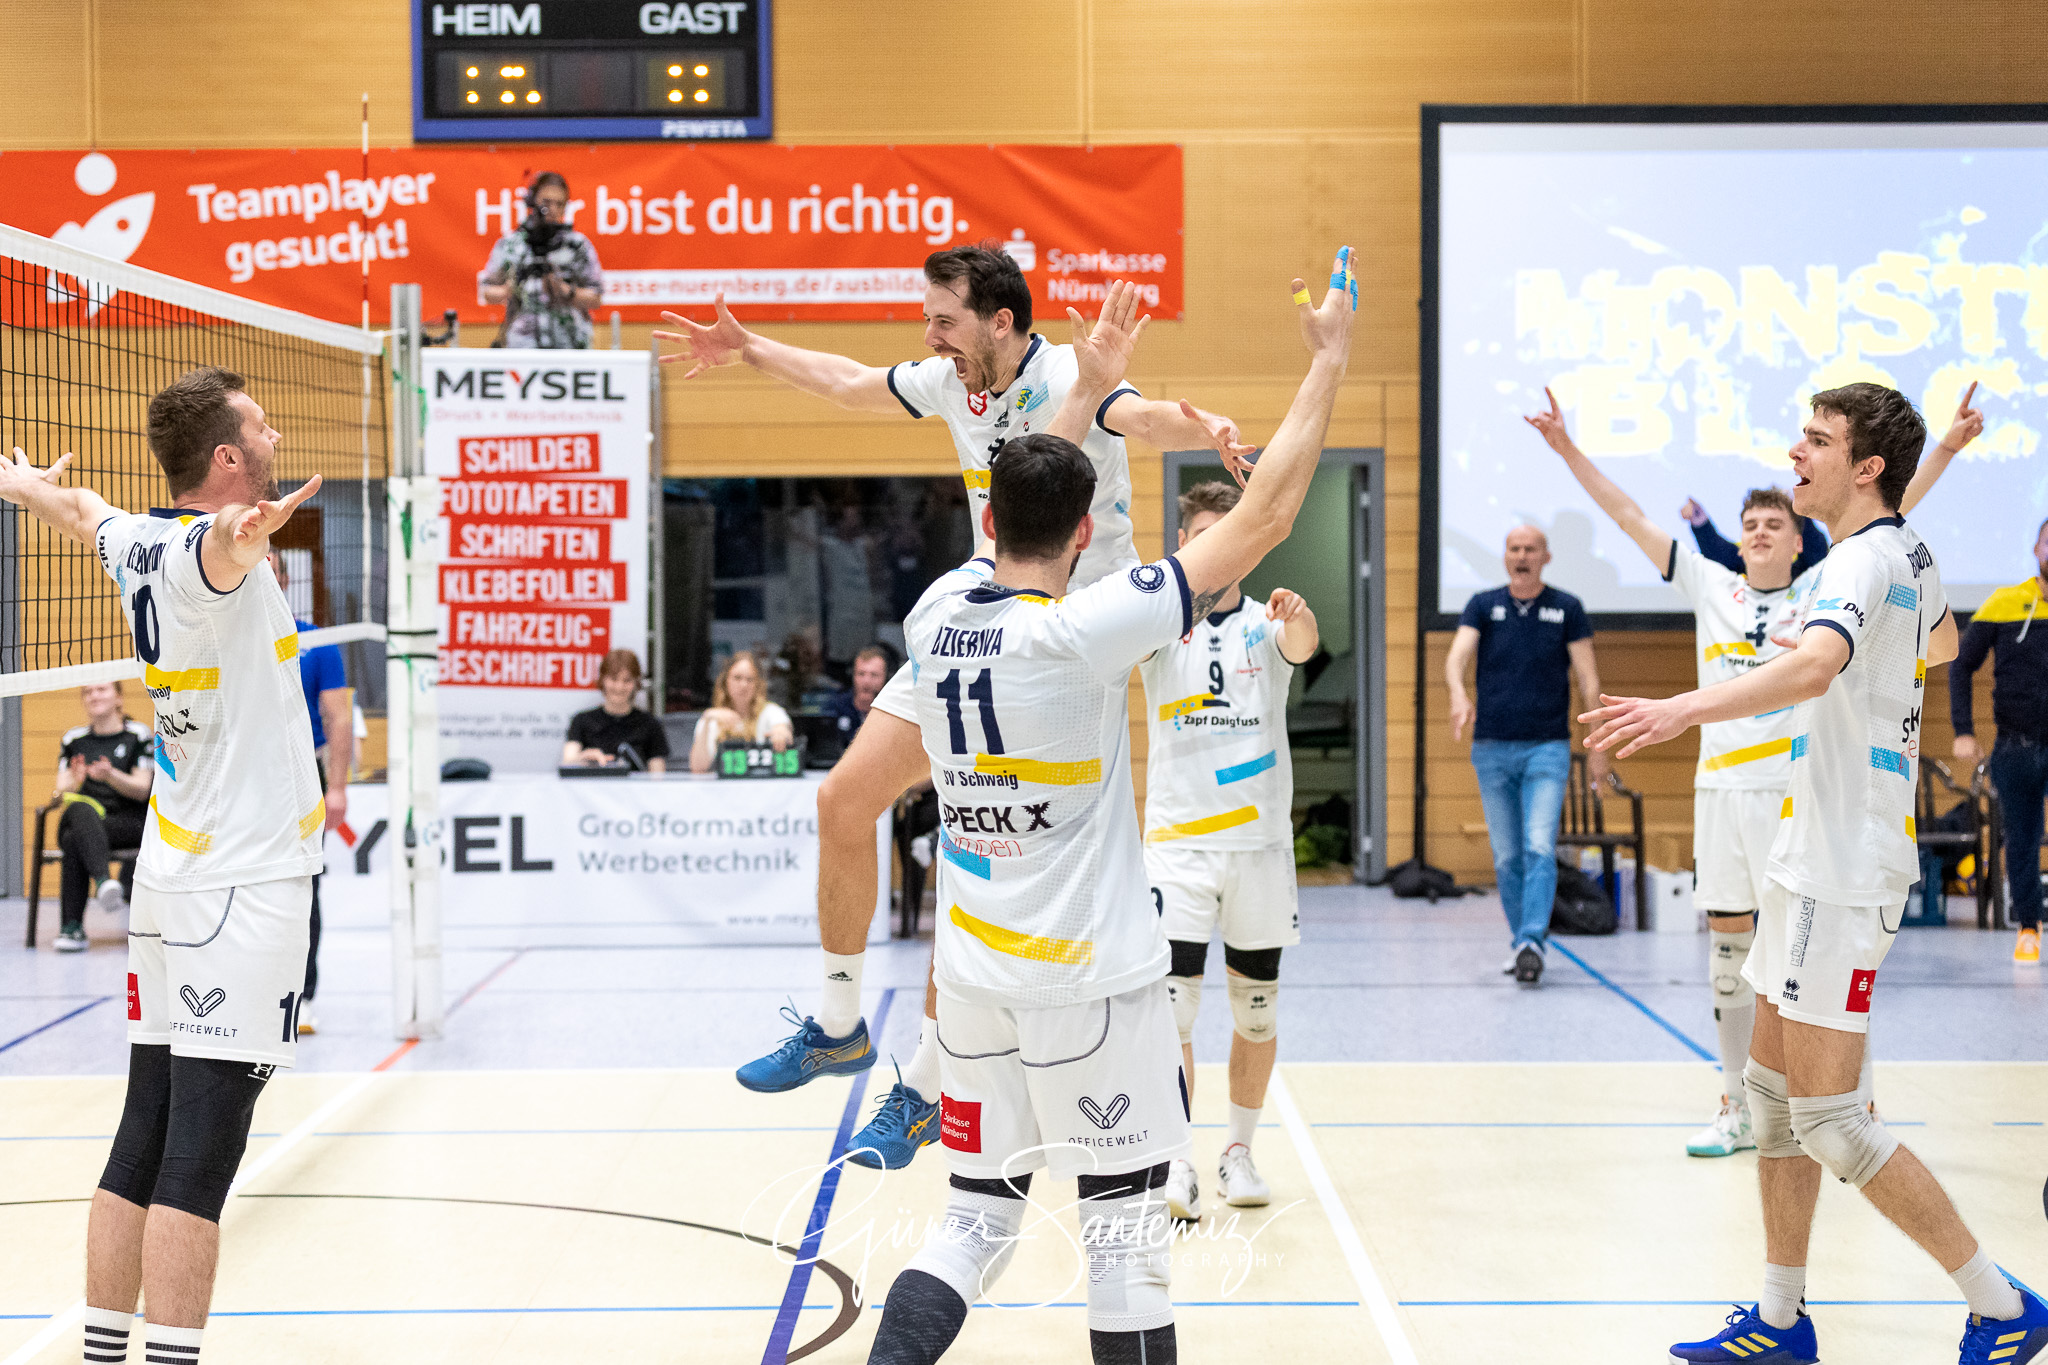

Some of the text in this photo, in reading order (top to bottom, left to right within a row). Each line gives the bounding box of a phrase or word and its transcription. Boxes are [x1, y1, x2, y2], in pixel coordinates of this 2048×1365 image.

[432, 2, 748, 35] HEIM GAST
[187, 170, 435, 223] Teamplayer
[476, 183, 969, 245] Hir bist du richtig.
[225, 219, 409, 283] gesucht!
[1047, 248, 1167, 276] Sparkasse
[1047, 278, 1160, 308] Nürnrg
[436, 369, 625, 401] MEYSEL
[464, 437, 592, 475] SCHILDER
[439, 479, 616, 518] FOTOTAPETEN
[460, 523, 600, 561] SCHRIFTEN
[443, 568, 615, 603] KLEBEFOLIEN
[131, 584, 160, 666] 10
[456, 610, 607, 647] FAHRZEUG-
[1208, 660, 1224, 695] 9
[936, 668, 1005, 755] 11
[1184, 715, 1209, 727] Zapf
[958, 770, 1019, 791] Schwaig
[578, 849, 801, 873] Werbetechnik
